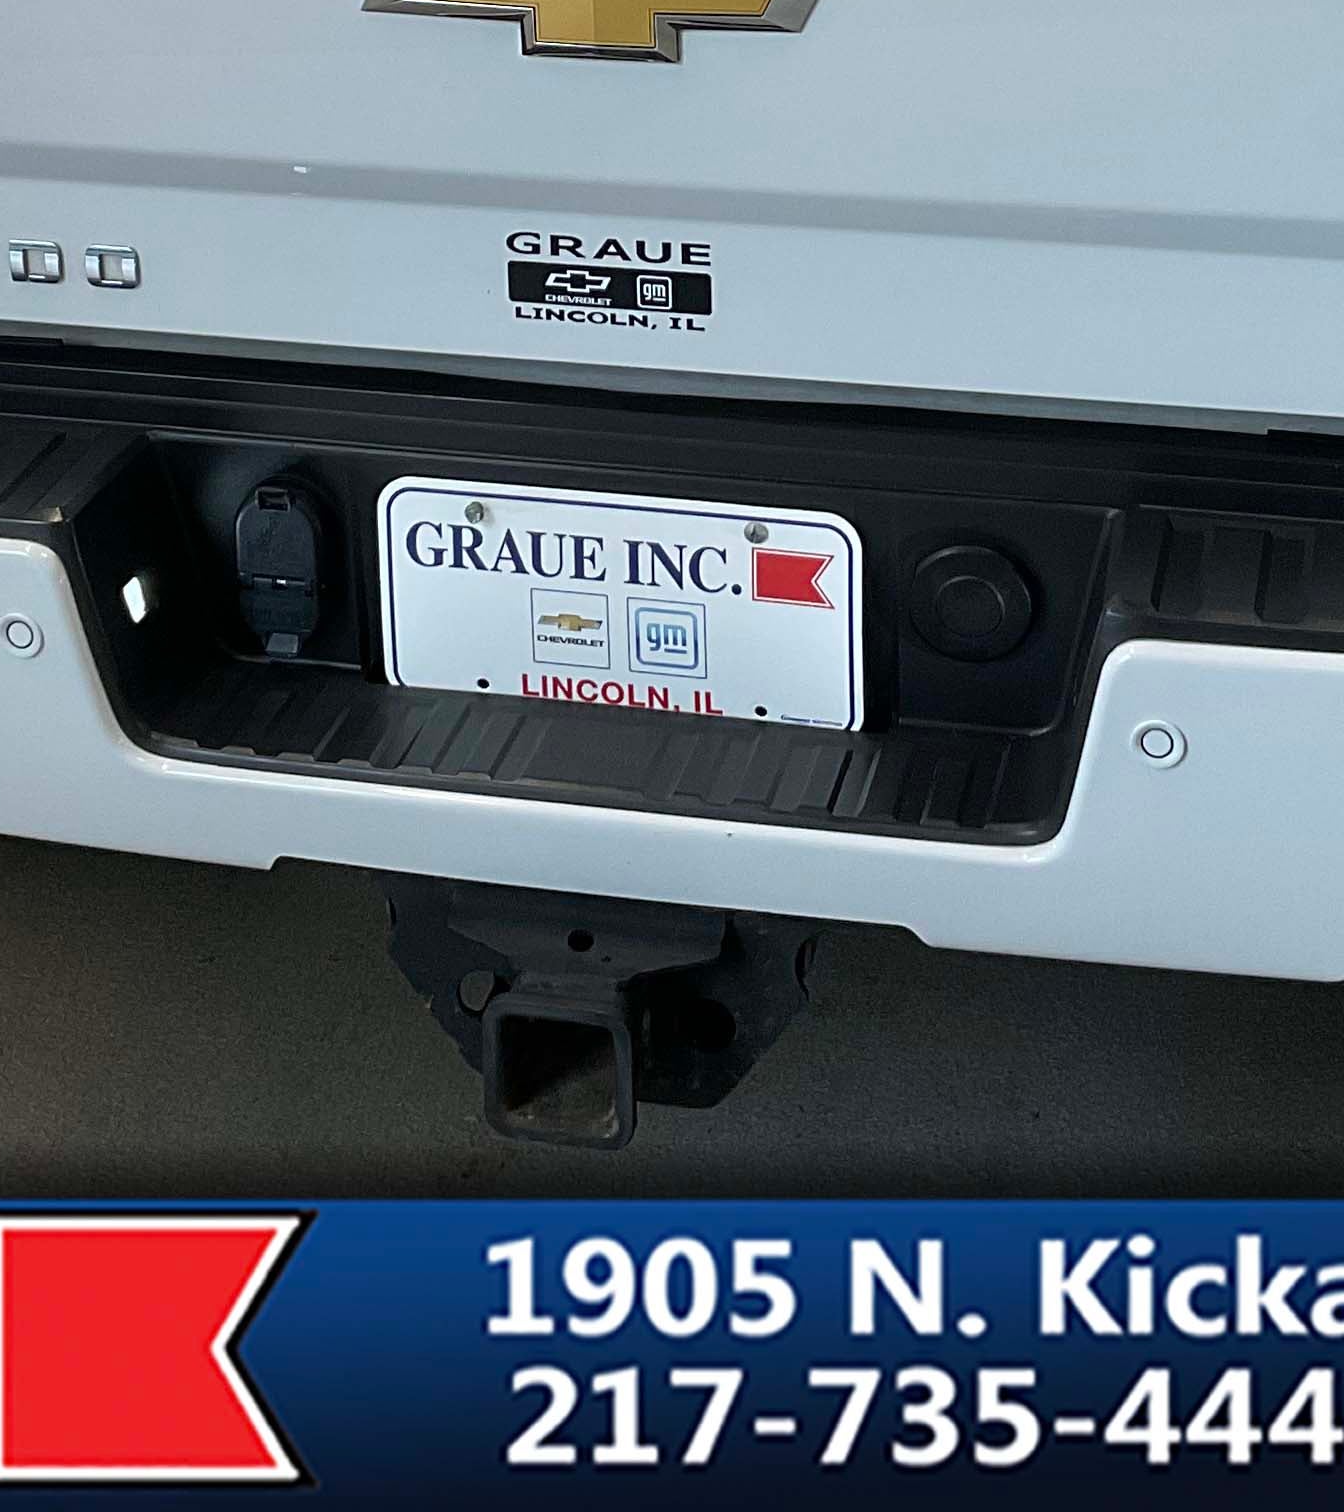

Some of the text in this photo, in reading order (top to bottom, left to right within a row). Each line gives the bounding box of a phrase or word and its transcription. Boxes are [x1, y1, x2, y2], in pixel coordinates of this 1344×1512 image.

[505, 231, 712, 267] GRAUE
[544, 293, 613, 306] CHEVROLET
[514, 306, 707, 332] LINCOLN, IL
[404, 520, 744, 596] GRAUE INC.
[536, 633, 606, 649] CHEVROLET
[693, 690, 725, 717] IL
